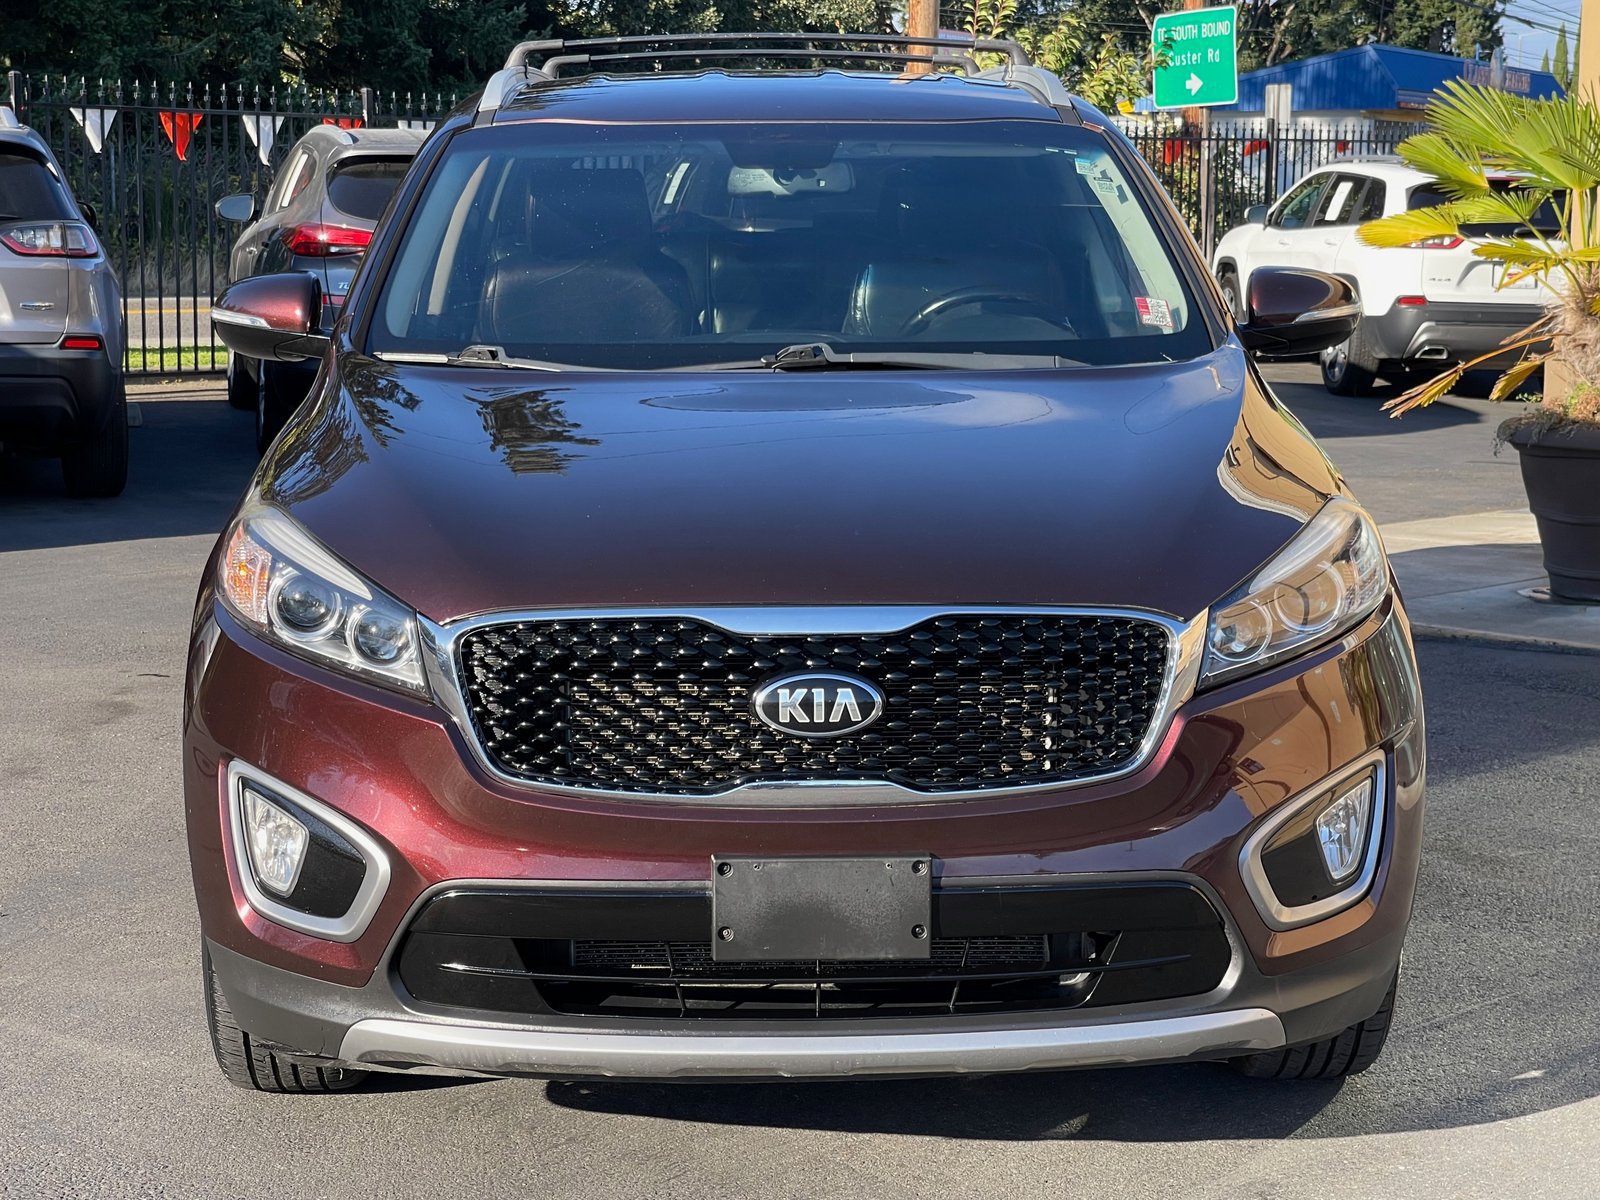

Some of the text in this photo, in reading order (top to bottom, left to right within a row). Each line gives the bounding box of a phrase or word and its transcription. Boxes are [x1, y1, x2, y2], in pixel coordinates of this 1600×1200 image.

[1171, 25, 1198, 41] SOUTH
[1201, 21, 1231, 38] BOUND
[1169, 48, 1220, 67] Custer Rd
[777, 688, 862, 723] KIA
